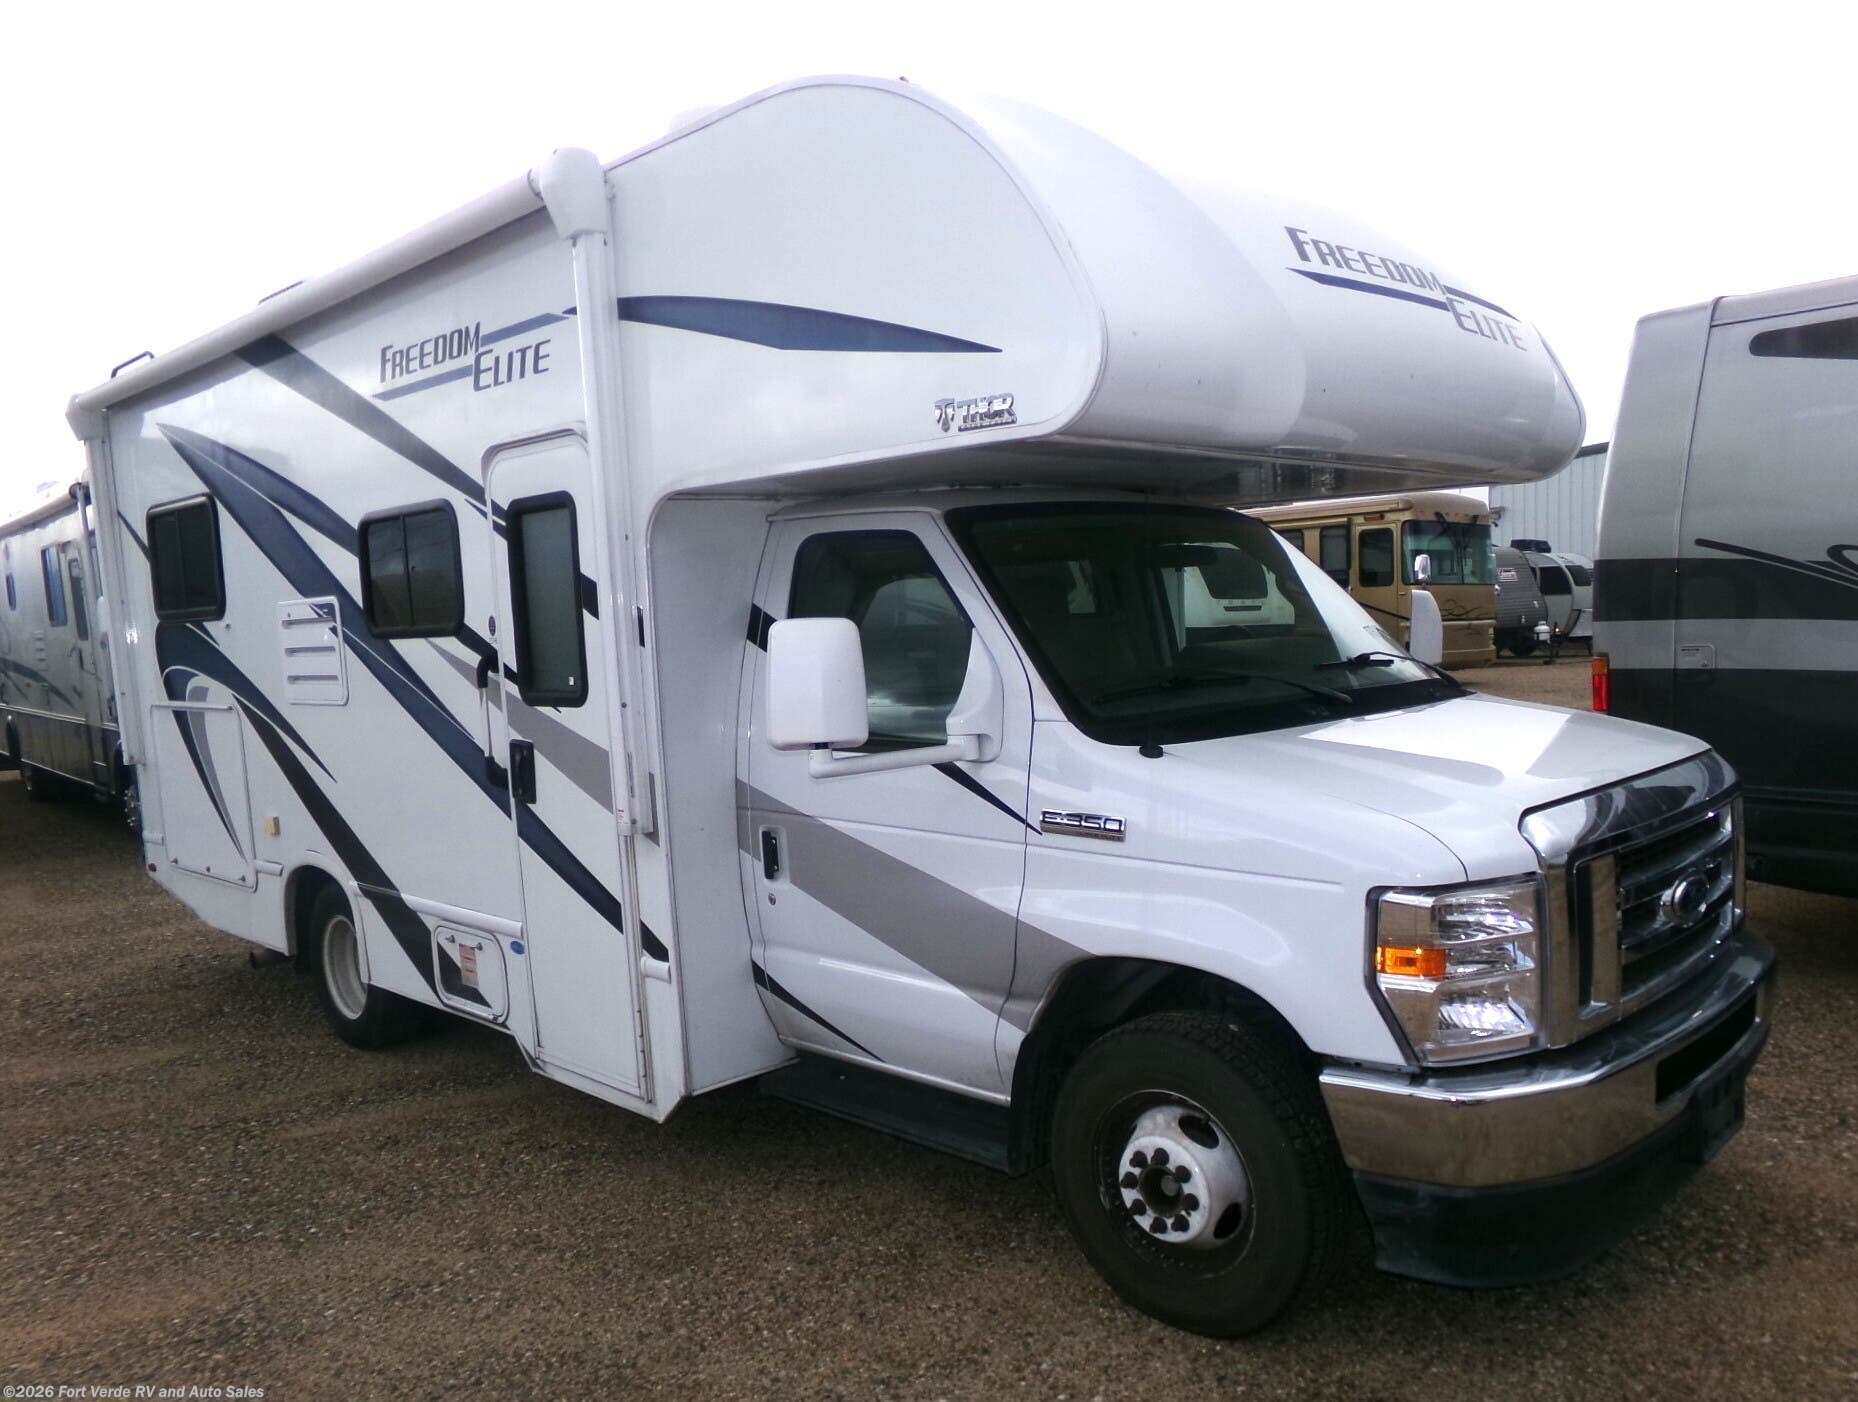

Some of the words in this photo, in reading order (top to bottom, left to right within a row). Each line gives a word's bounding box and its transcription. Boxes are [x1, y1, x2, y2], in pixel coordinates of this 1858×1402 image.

[1284, 226, 1448, 296] FREEDOM
[380, 321, 481, 383] FREEDOM
[1446, 296, 1528, 352] ELITE
[473, 339, 551, 392] ELITE
